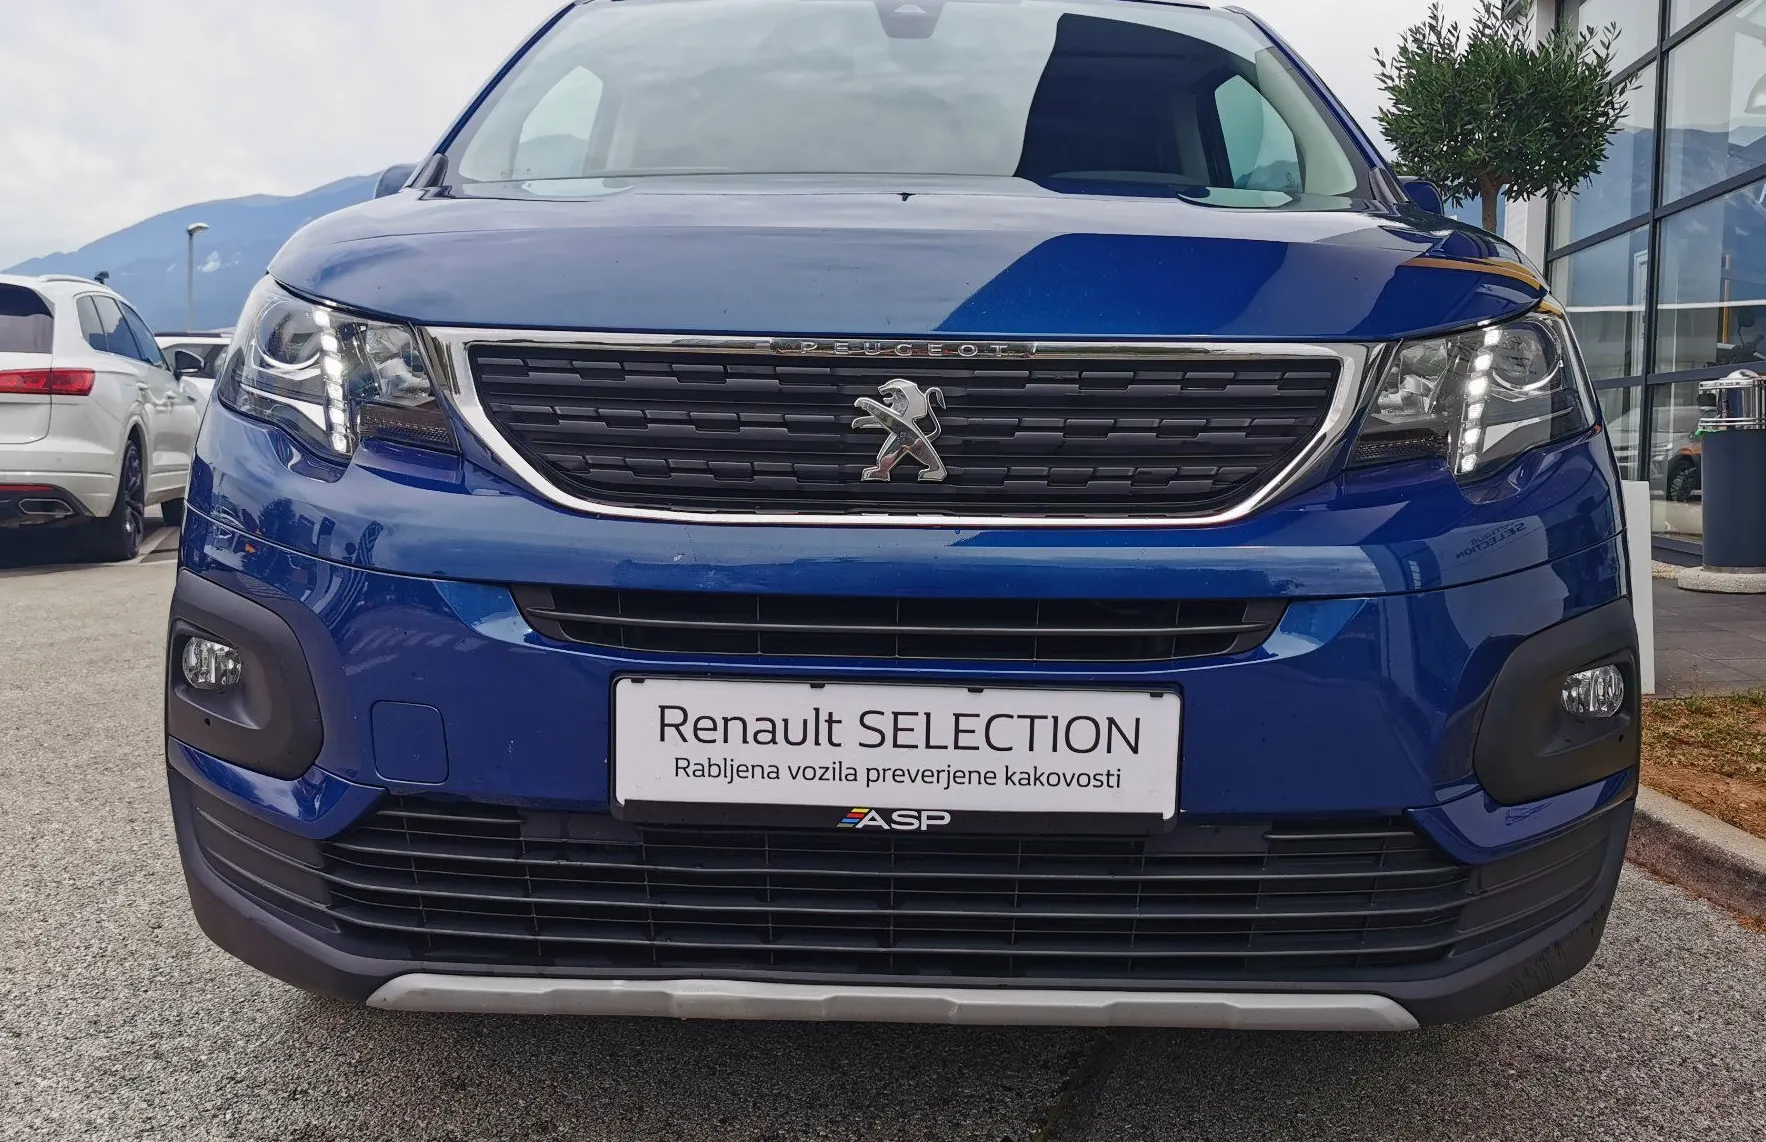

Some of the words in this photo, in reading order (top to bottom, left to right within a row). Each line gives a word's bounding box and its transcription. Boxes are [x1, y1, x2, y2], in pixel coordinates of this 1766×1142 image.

[800, 341, 1008, 357] PEUGEOT
[658, 704, 843, 748] Renault
[858, 709, 1141, 755] SELECTION
[674, 757, 781, 785] Rabljena
[787, 760, 858, 782] vozila
[865, 764, 997, 791] preverjene
[1004, 764, 1121, 789] kakovosti
[855, 809, 952, 831] ASP
